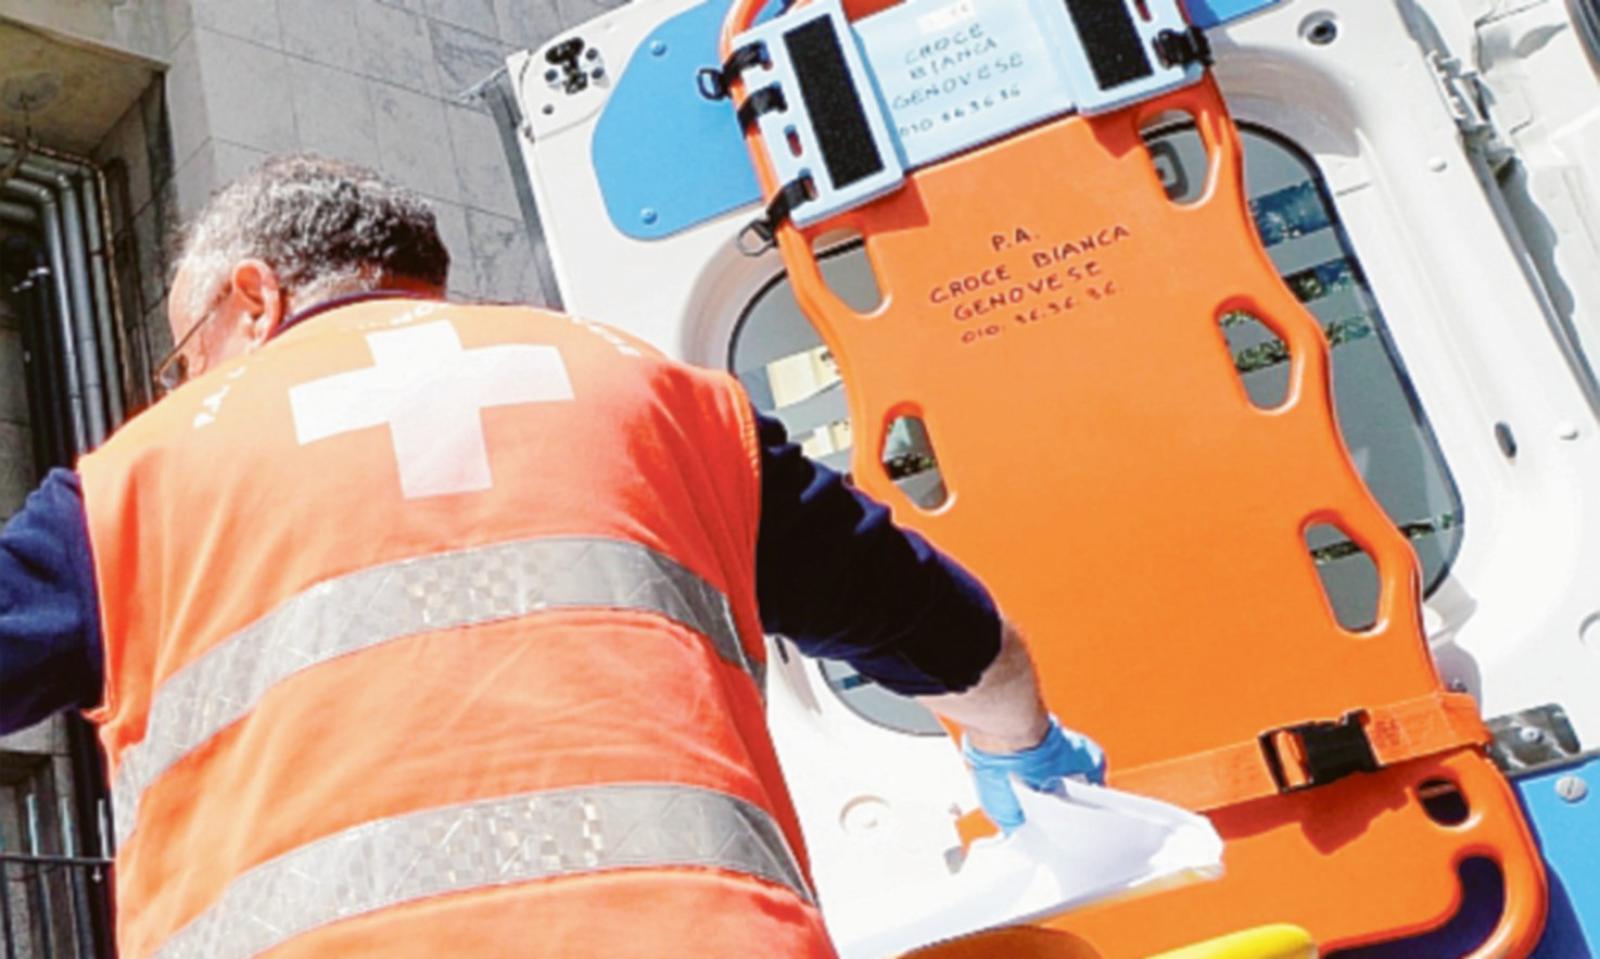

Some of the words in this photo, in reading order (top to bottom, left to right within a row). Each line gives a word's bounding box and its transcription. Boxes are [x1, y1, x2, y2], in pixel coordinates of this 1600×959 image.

[905, 24, 983, 64] CROCE
[909, 37, 997, 79] BIANCA
[892, 53, 1023, 110] GENOVESE
[930, 264, 1011, 304] CROCE
[1032, 226, 1130, 268] BIANCA
[954, 261, 1102, 321] GENOVESE
